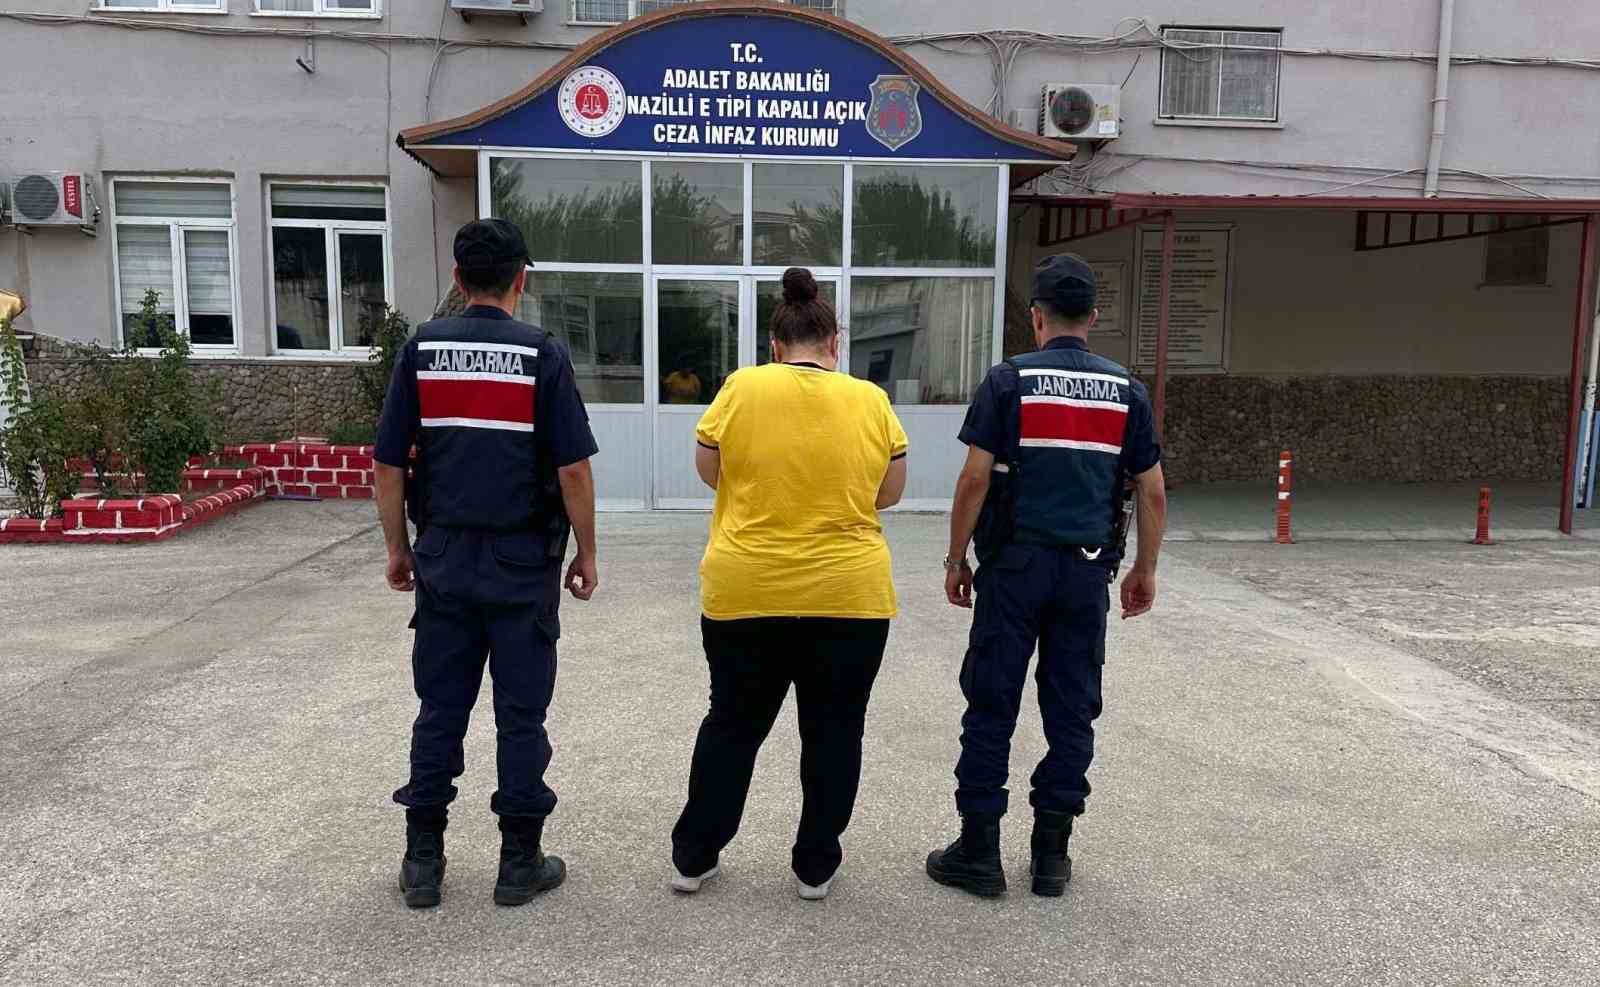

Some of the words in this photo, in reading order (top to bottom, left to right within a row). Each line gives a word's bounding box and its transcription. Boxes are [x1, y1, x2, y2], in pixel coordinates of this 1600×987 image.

[730, 43, 763, 63] T.C.
[663, 69, 731, 90] ADALET
[736, 68, 830, 93] BAKANLIĞI
[627, 92, 694, 117] NAZİLLİ
[700, 98, 710, 117] E
[717, 94, 751, 118] TİPİ
[757, 99, 819, 120] KAPALI
[824, 101, 867, 125] AÇIK
[653, 123, 700, 144] CEZA
[705, 120, 756, 146] İNFAZ
[761, 126, 839, 148] KURUMU
[428, 349, 524, 375] JANDARMA
[1032, 375, 1121, 402] JANDARMA
